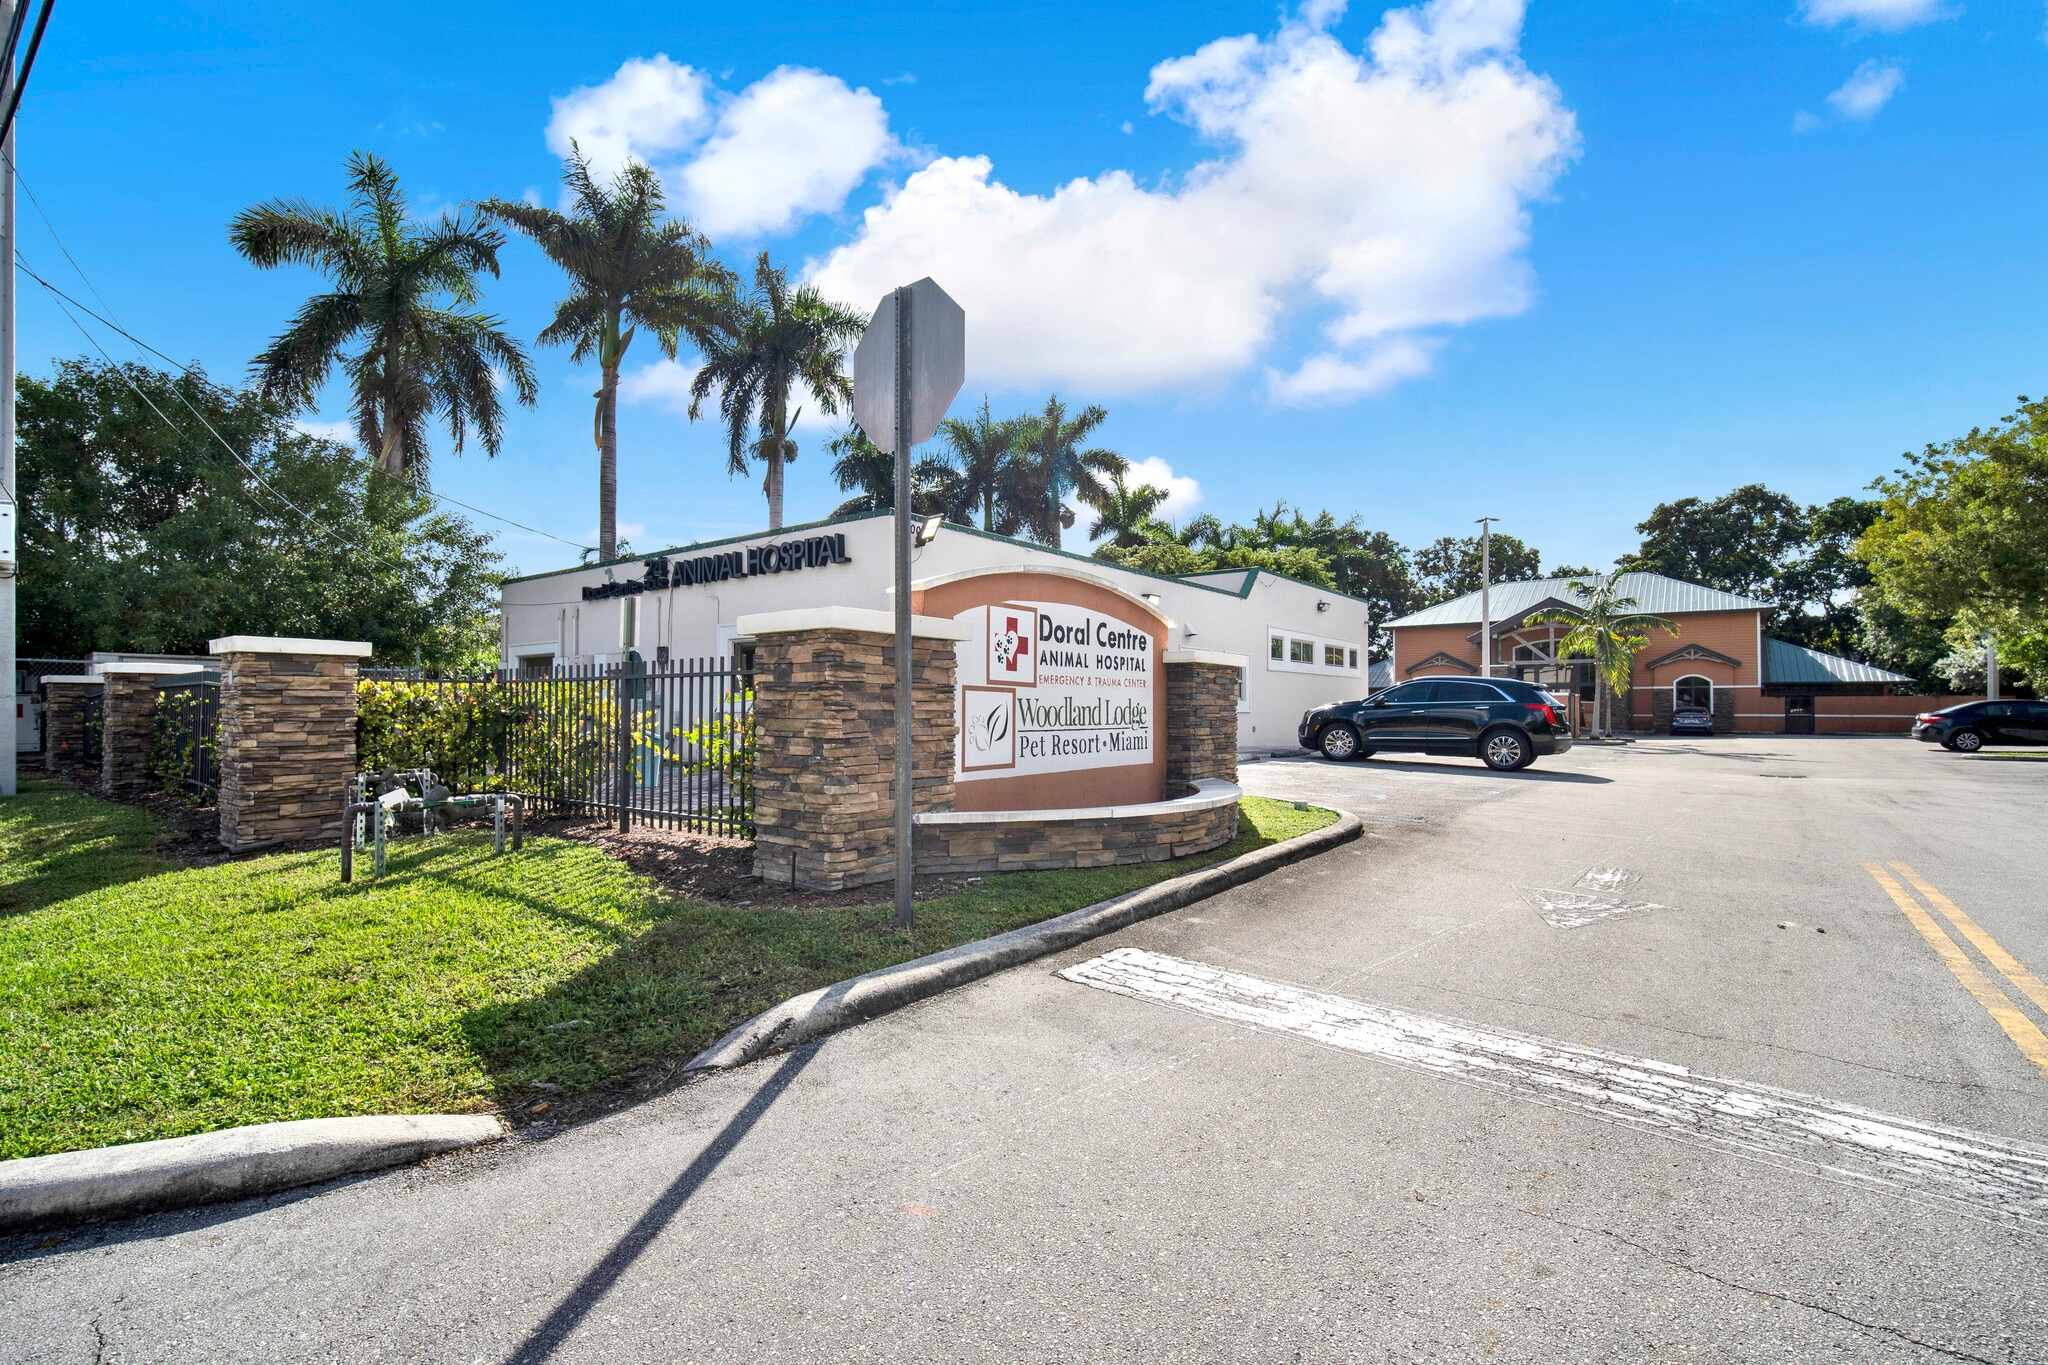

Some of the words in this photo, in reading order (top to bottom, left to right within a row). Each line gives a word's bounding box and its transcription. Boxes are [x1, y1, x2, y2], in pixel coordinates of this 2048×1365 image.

[644, 556, 669, 579] 24
[671, 551, 748, 587] ANIMAL
[747, 533, 852, 577] HOSPITAL
[1039, 613, 1090, 646] Doral
[1096, 622, 1147, 652] Centre
[1039, 649, 1089, 669] ANIMAL
[1096, 654, 1146, 673] HOSPITAL
[1038, 674, 1085, 687] EMERGENCY
[1087, 676, 1092, 686] &
[1095, 677, 1121, 688] TRAUMA
[1123, 678, 1147, 689] CENTER
[1017, 696, 1102, 728] Woodland
[1104, 698, 1147, 731] Lodge
[1019, 735, 1047, 758] Pet
[1051, 733, 1101, 757] Resort
[1109, 730, 1149, 752] Miami
